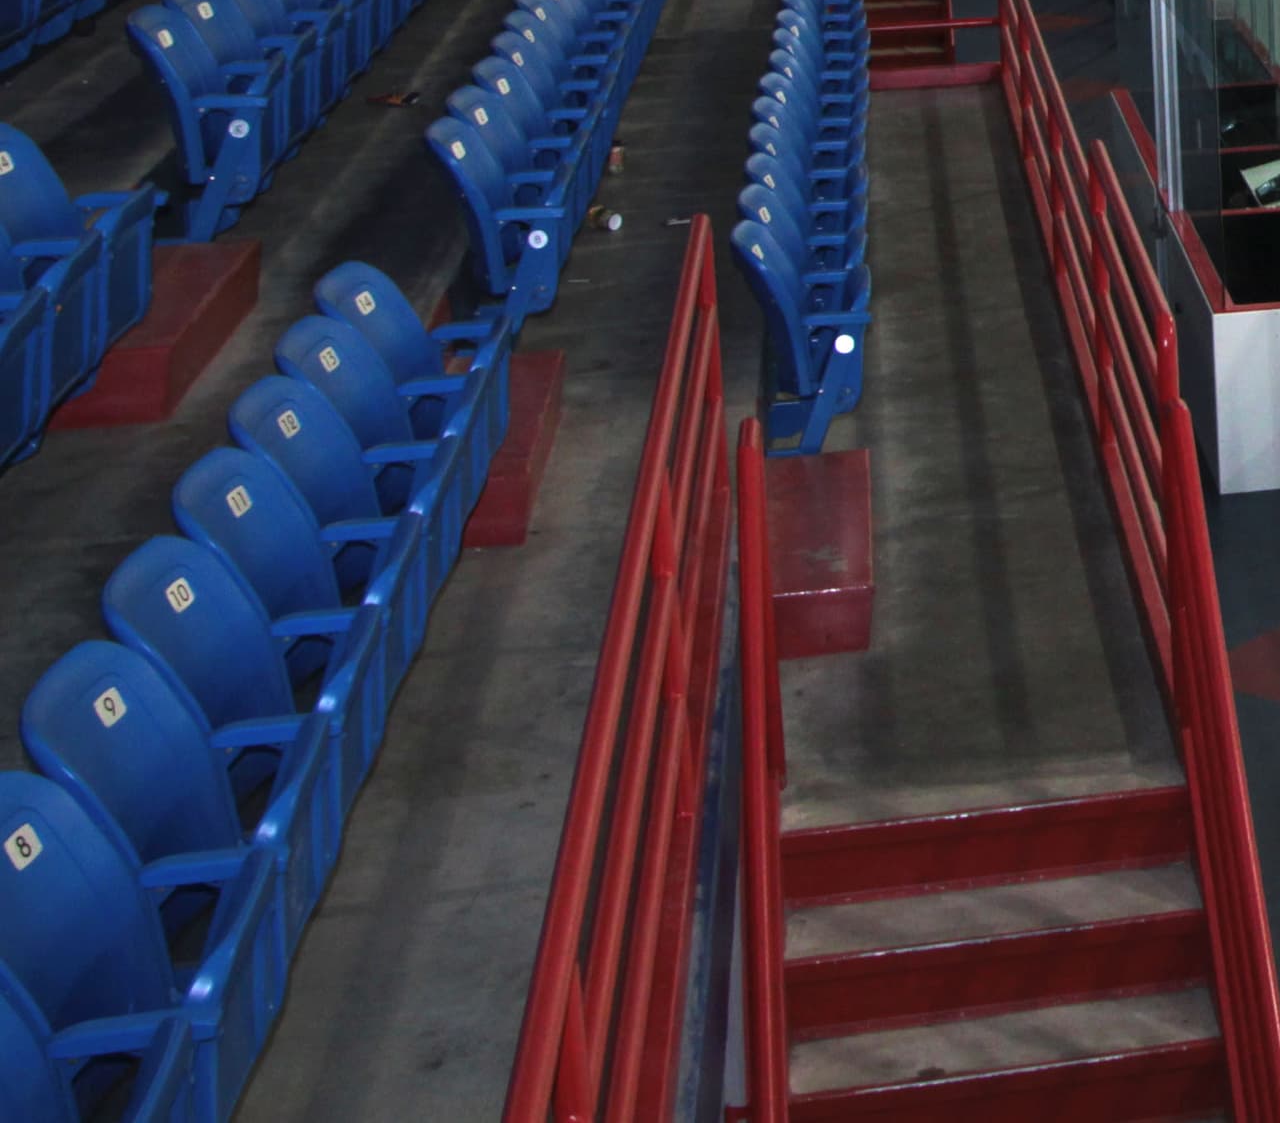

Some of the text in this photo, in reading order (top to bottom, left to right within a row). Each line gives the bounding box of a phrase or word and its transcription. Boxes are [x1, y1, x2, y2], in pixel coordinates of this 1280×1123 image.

[231, 491, 248, 512] 11
[169, 583, 190, 607] 10
[103, 696, 116, 716] 9
[16, 835, 32, 858] 8
